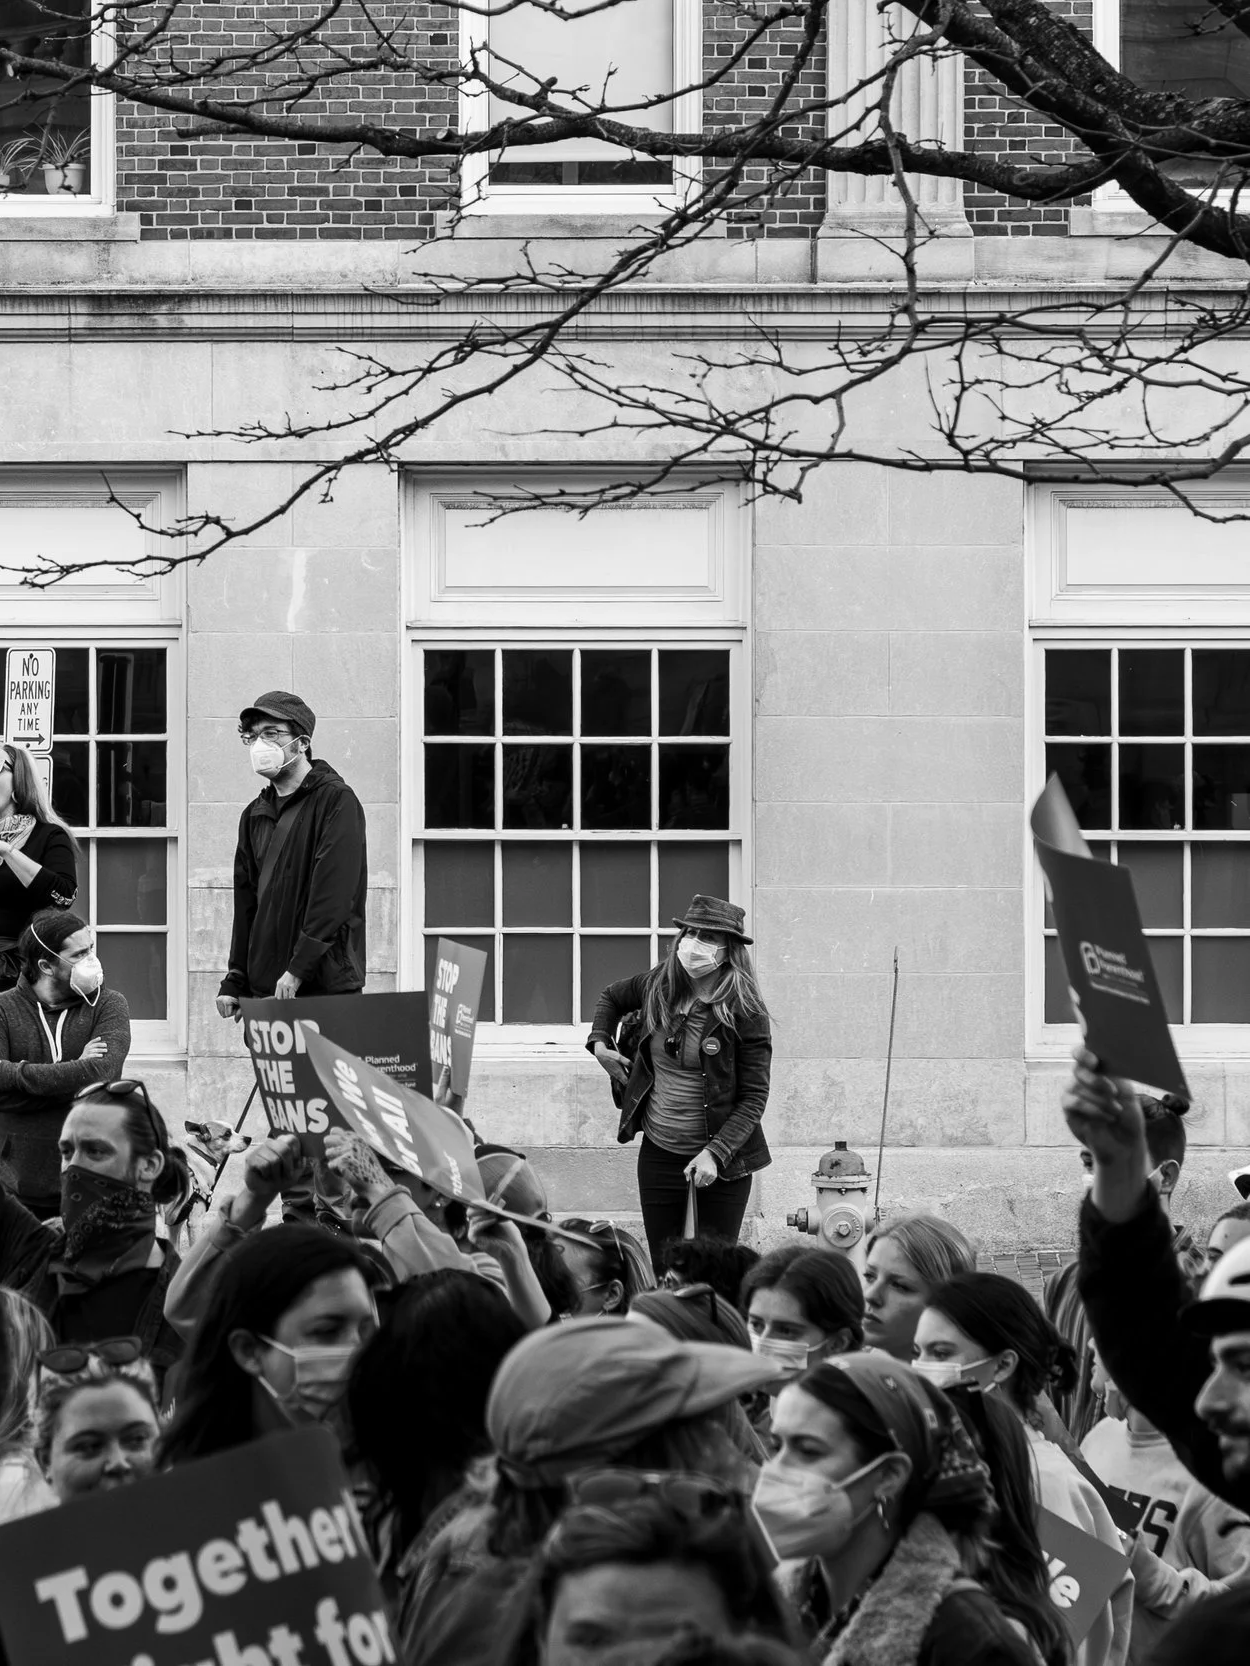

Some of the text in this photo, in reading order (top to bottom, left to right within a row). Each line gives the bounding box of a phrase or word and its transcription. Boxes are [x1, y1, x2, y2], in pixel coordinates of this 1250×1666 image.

[22, 657, 39, 677] NO
[10, 680, 51, 700] PARKING
[18, 718, 40, 731] TIME
[20, 702, 39, 715] ANY
[436, 958, 460, 994] STOP
[432, 993, 449, 1029] THE
[249, 1019, 321, 1055] STOP
[255, 1058, 296, 1094] THE
[266, 1096, 329, 1134] BANS
[371, 1085, 414, 1144] All
[34, 1490, 364, 1644] Together
